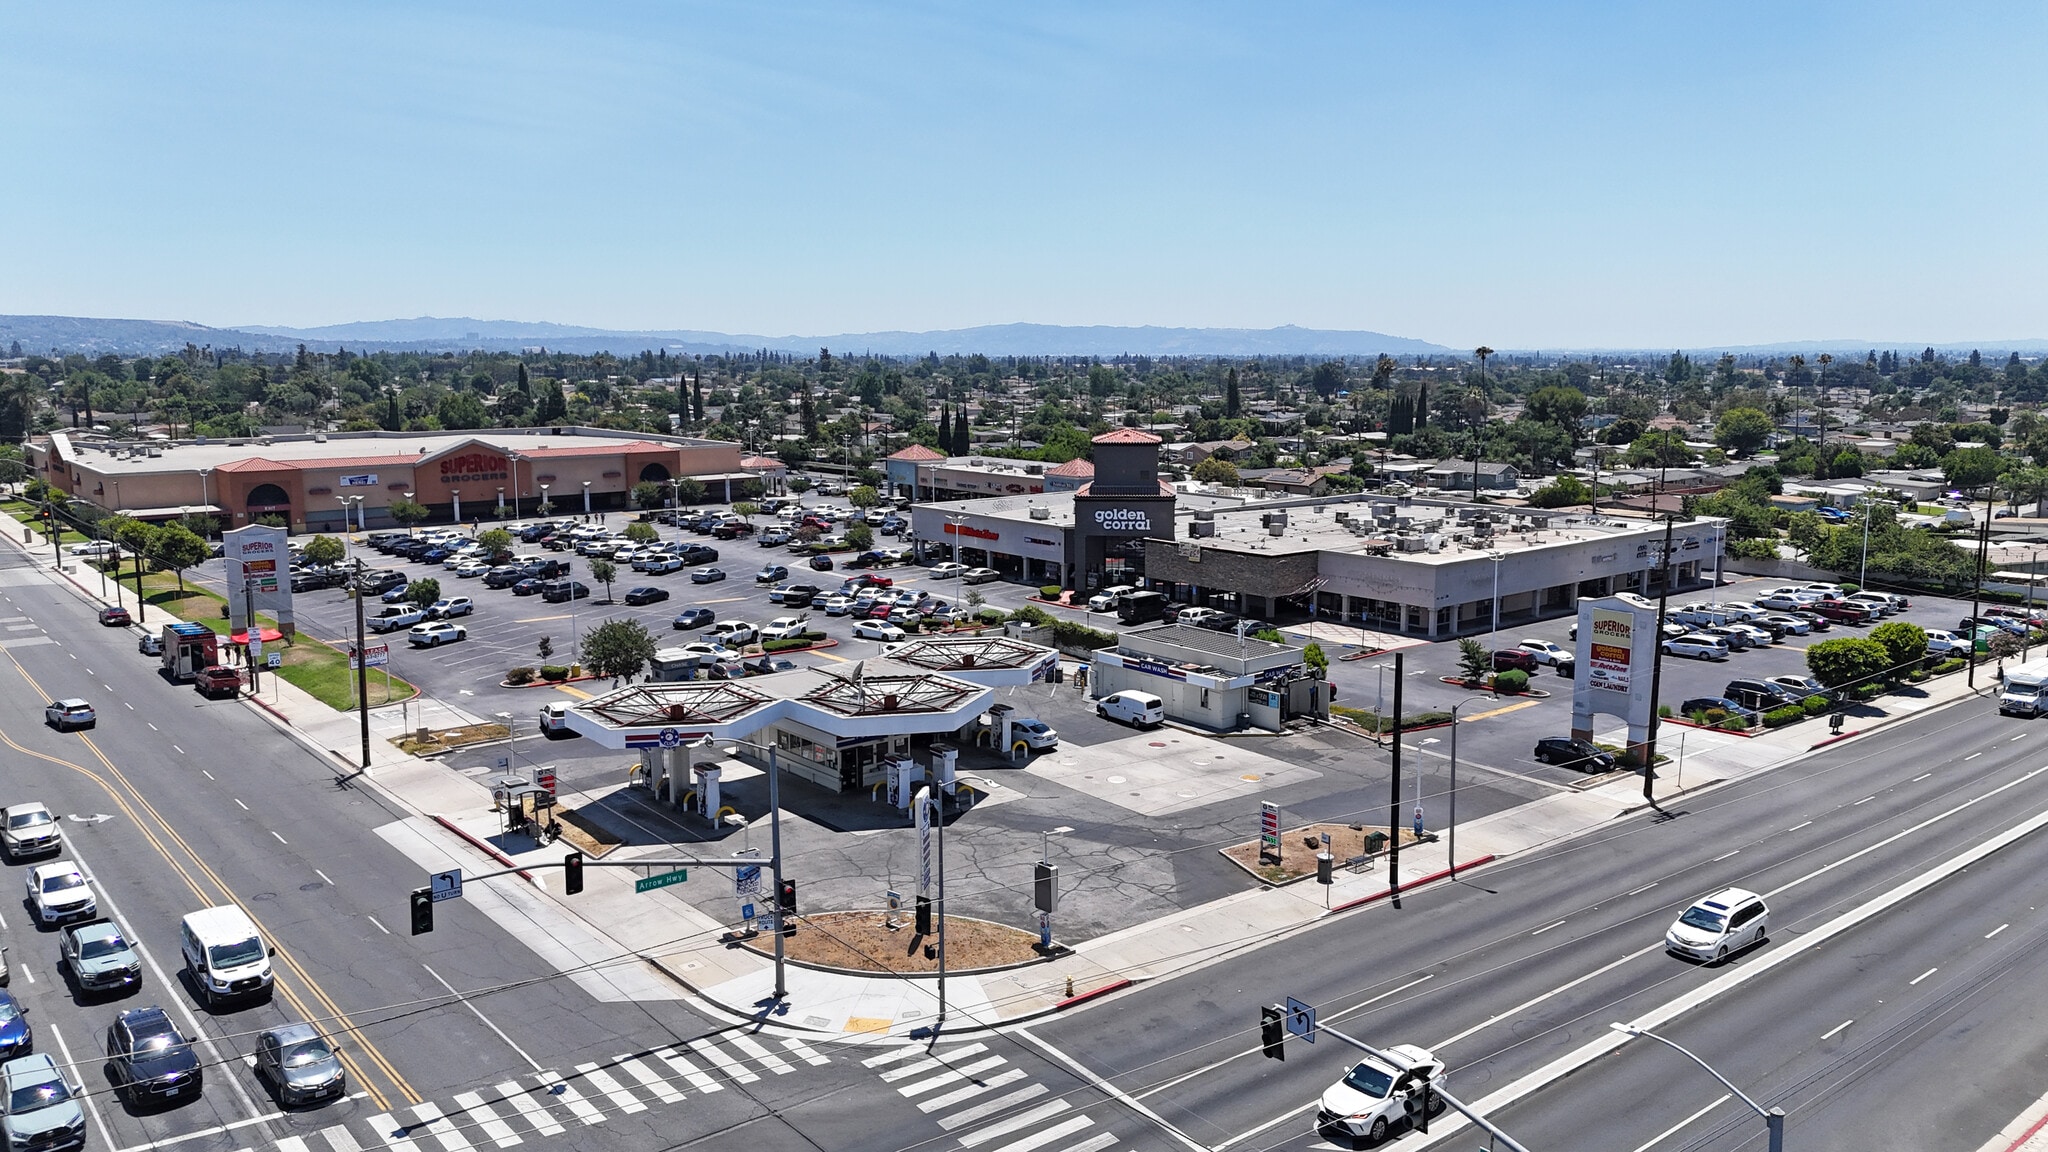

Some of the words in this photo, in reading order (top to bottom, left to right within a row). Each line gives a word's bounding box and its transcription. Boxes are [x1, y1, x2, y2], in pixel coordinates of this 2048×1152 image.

[440, 453, 508, 474] SUPERIOR
[440, 472, 507, 483] GROCERS
[1094, 508, 1146, 523] golden
[1103, 519, 1151, 530] corral
[242, 541, 274, 552] SUPERIOR
[1594, 619, 1631, 634] SUPERIOR
[1593, 629, 1631, 639] GROCERS
[1596, 644, 1623, 654] golden
[1600, 651, 1625, 660] corral
[671, 661, 688, 669] CHASE
[1140, 663, 1152, 671] CAR
[1152, 666, 1168, 675] WASH
[1598, 662, 1628, 673] AutoZone
[1264, 671, 1276, 679] CAR
[1603, 682, 1629, 693] LAUNDRY
[639, 879, 663, 890] Arrow
[666, 874, 683, 884] Hwy
[441, 891, 447, 899] U
[447, 889, 461, 897] TURN
